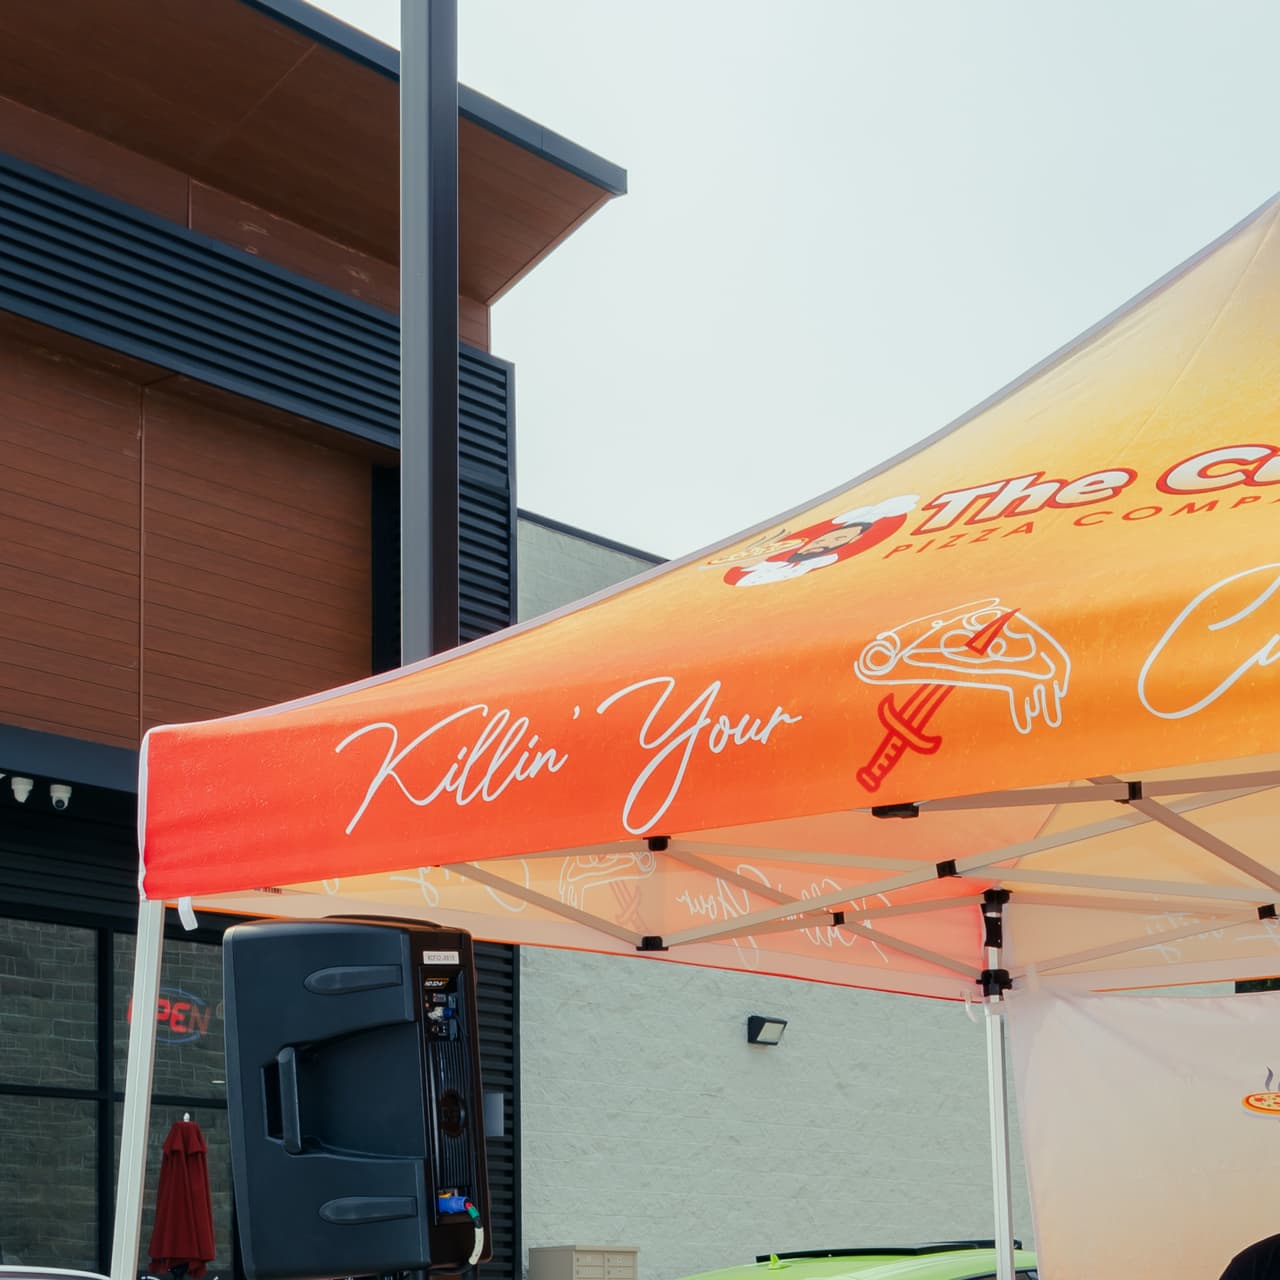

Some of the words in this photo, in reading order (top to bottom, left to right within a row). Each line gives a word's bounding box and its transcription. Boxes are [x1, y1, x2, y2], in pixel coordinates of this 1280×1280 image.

[922, 466, 1138, 537] The
[882, 520, 1034, 559] PIZZA
[599, 675, 802, 836] Your
